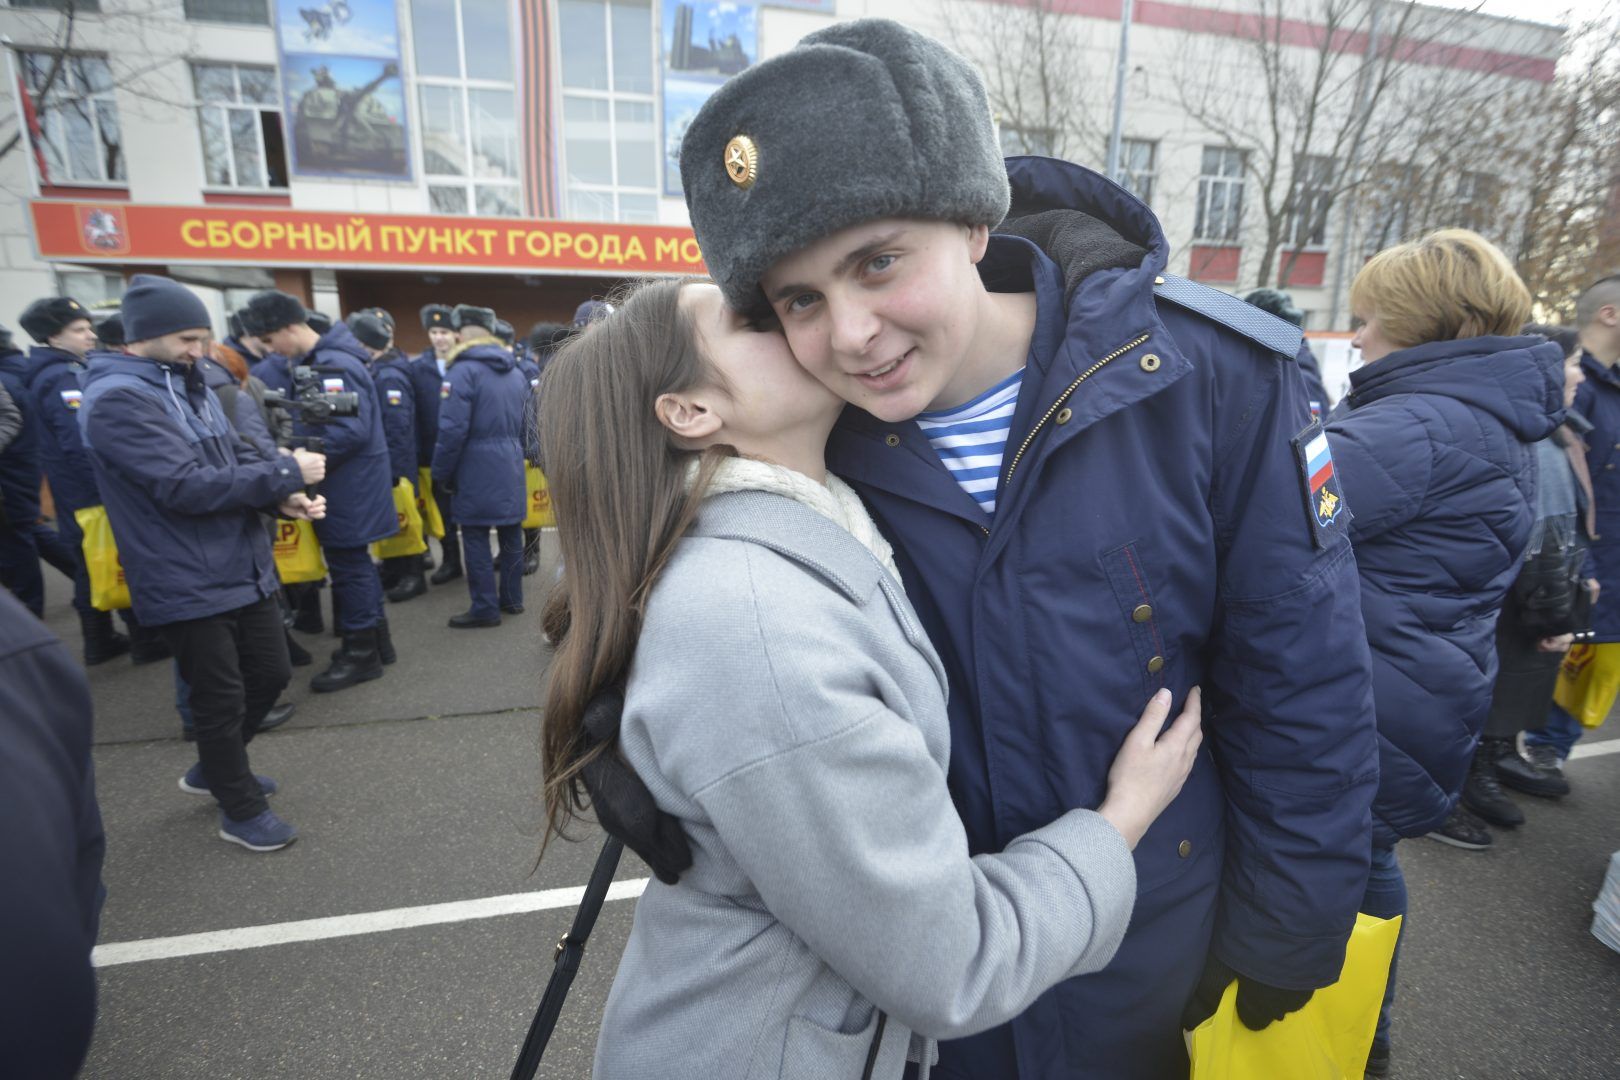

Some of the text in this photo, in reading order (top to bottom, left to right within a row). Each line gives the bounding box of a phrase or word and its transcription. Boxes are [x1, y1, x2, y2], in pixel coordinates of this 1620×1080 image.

[181, 217, 372, 252] СБОРНЫЙ
[379, 225, 497, 255] ПУНКТ
[507, 230, 647, 264] ГОРОДА
